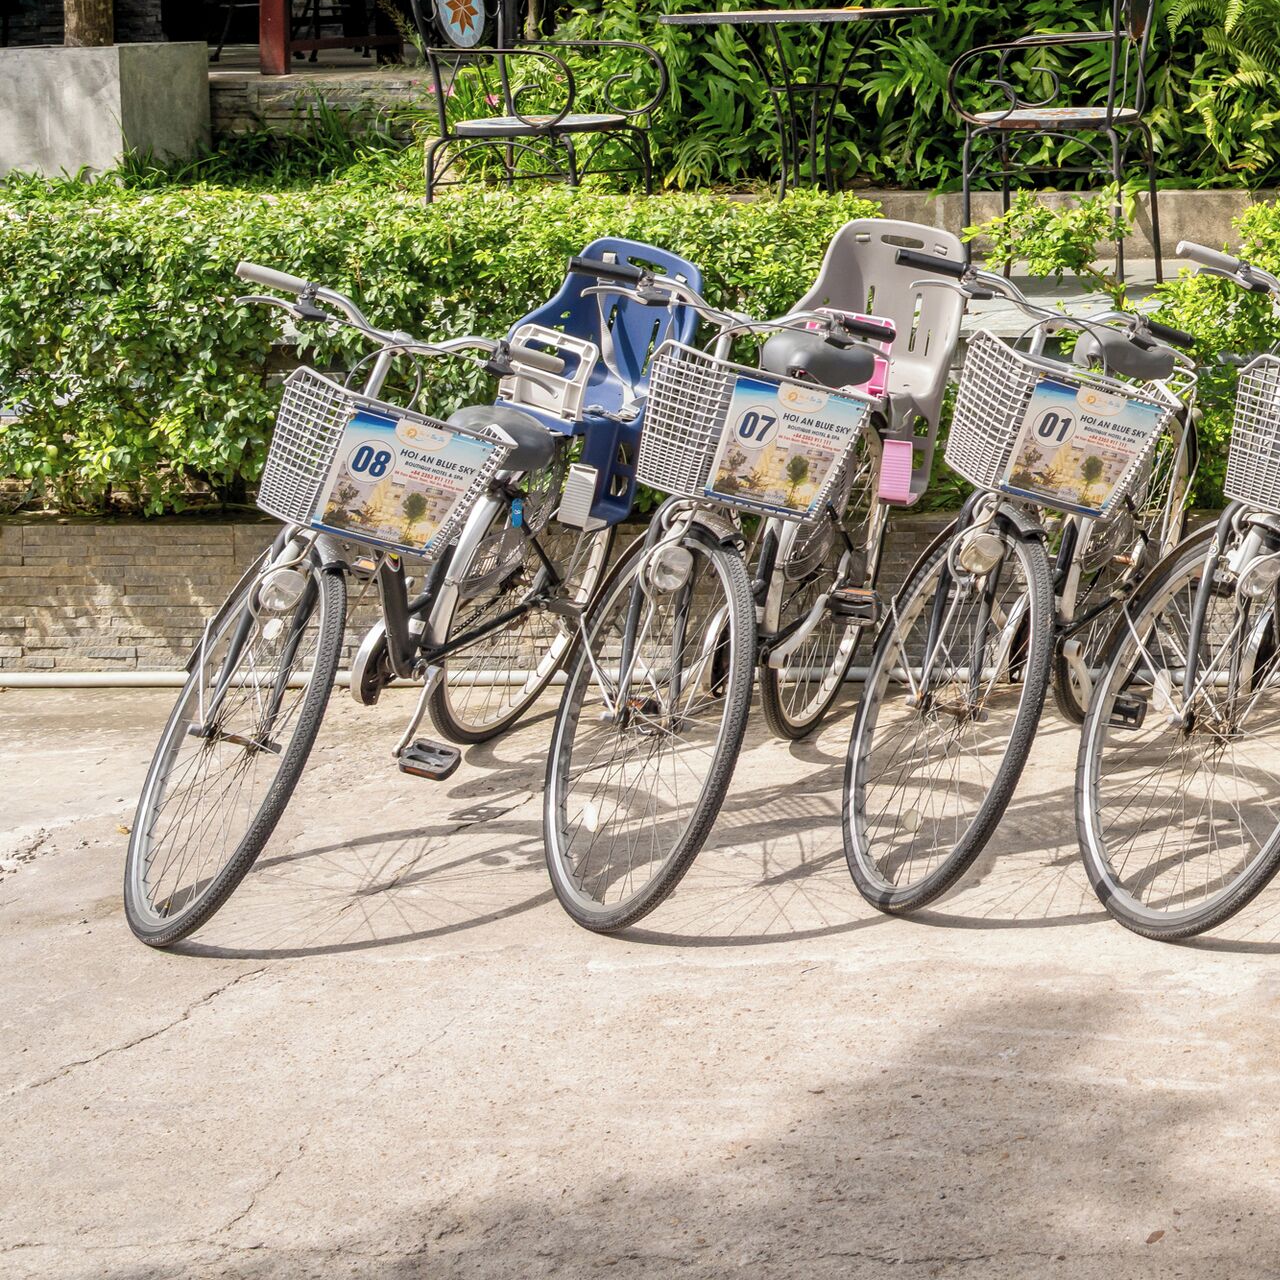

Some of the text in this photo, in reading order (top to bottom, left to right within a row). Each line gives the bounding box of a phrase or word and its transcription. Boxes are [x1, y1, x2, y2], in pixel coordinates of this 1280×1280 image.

[739, 411, 776, 442] 07
[782, 412, 851, 435] HOI AN BLUE SKY
[1038, 412, 1072, 442] 01
[1079, 414, 1148, 438] HOI AN BLUE SKY
[352, 445, 391, 477] 08
[400, 448, 476, 475] HOI AN BLUE SKY
